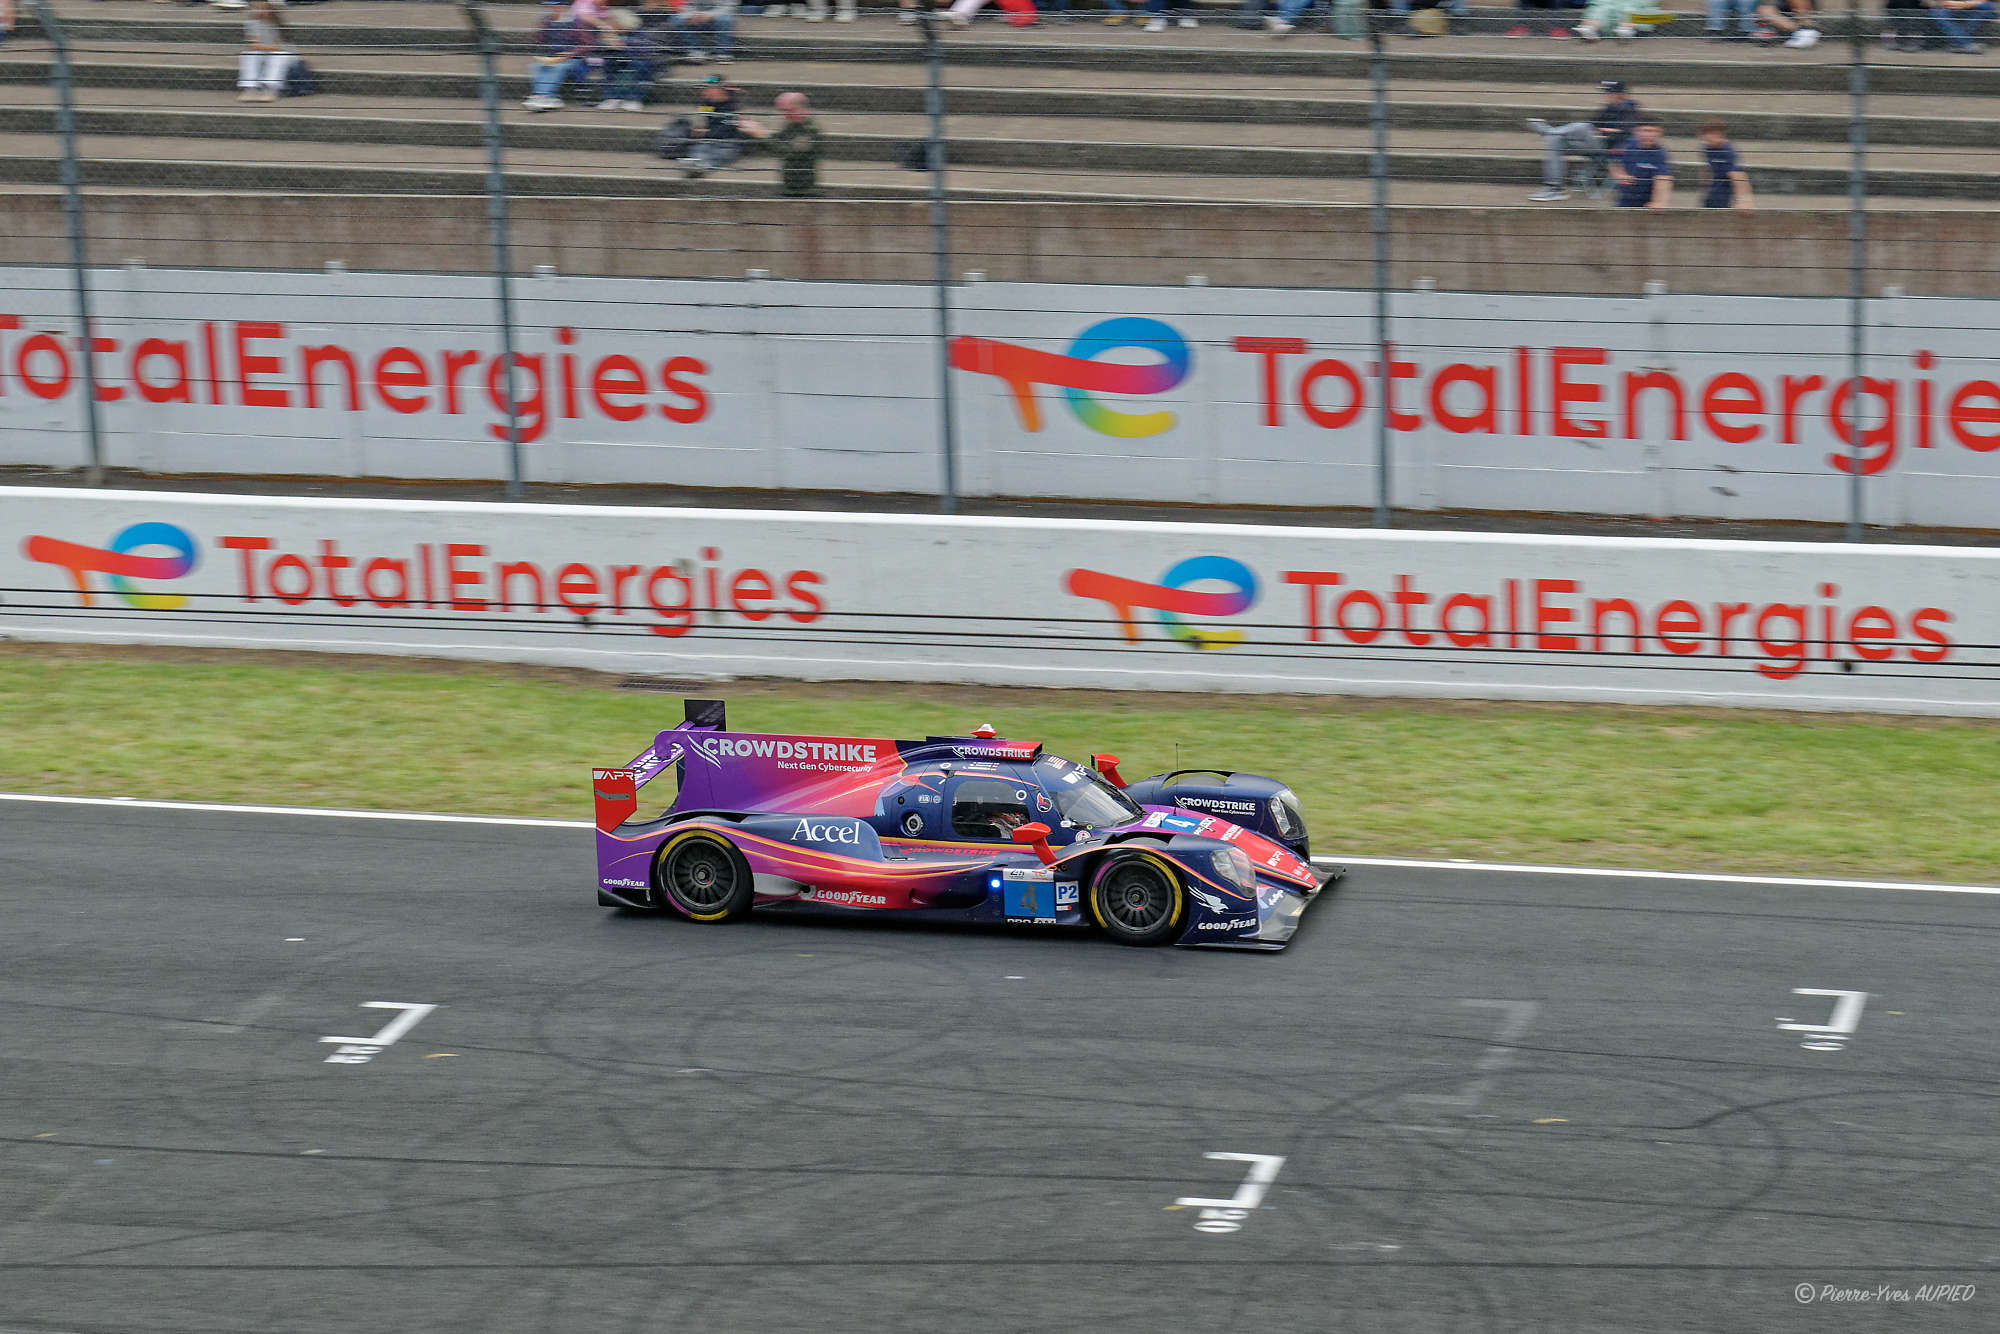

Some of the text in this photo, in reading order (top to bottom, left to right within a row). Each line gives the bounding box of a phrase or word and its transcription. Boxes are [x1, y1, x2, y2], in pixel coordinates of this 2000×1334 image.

[0, 314, 710, 443] otalEnergies
[220, 536, 826, 637] TotalEnergies
[1284, 571, 1953, 680] TotalEnergies
[703, 738, 877, 763] CROWDSTRIKE
[958, 746, 1031, 758] CROWDSTRIKE
[777, 761, 798, 770] Next
[818, 762, 873, 773] Cybersecurity
[1180, 797, 1256, 811] CROWDSTRIKE
[791, 818, 860, 844] Accel
[603, 878, 645, 888] GOODYEAR
[817, 890, 886, 904] GOODYEAR
[1021, 884, 1038, 914] 4
[1058, 886, 1077, 899] P2
[1198, 918, 1257, 931] GOODYEAR
